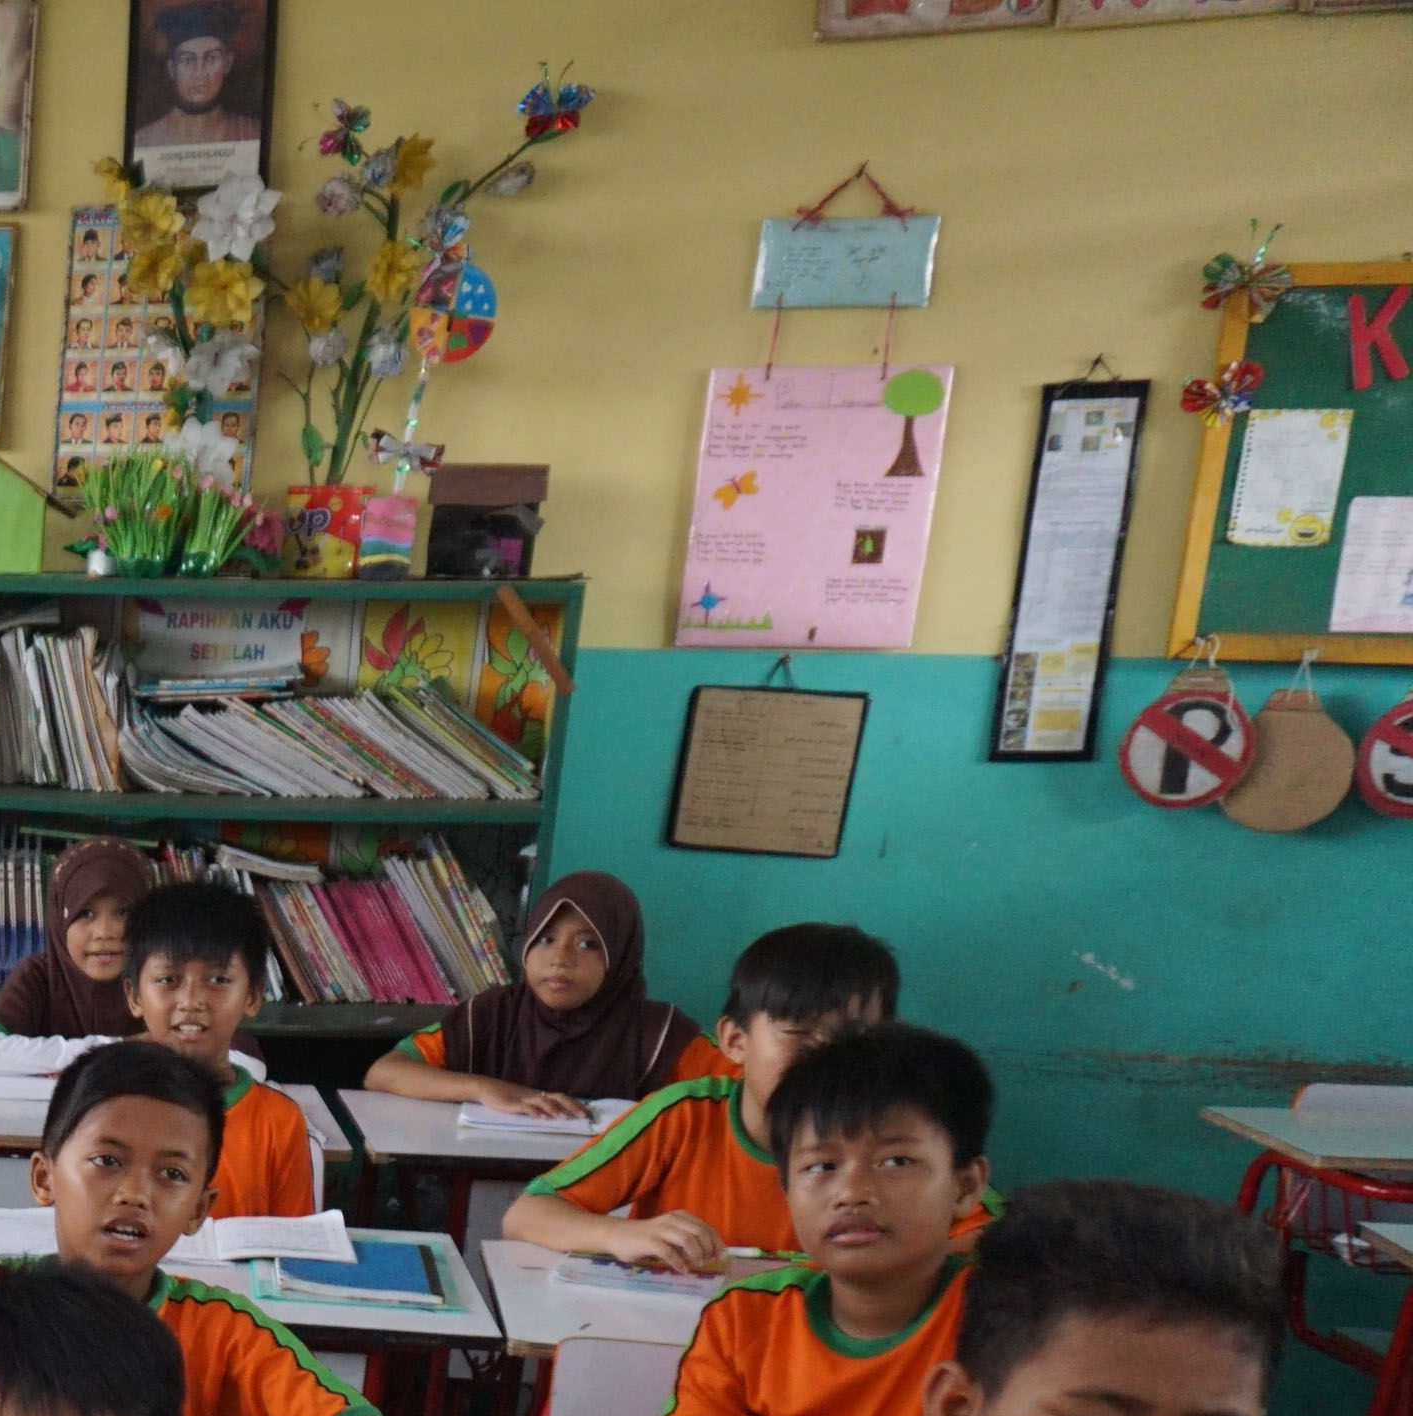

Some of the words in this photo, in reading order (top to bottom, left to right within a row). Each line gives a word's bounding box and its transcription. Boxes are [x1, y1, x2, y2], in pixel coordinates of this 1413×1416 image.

[1348, 284, 1411, 391] K
[258, 613, 294, 630] AKU
[190, 643, 266, 661] SETELAH
